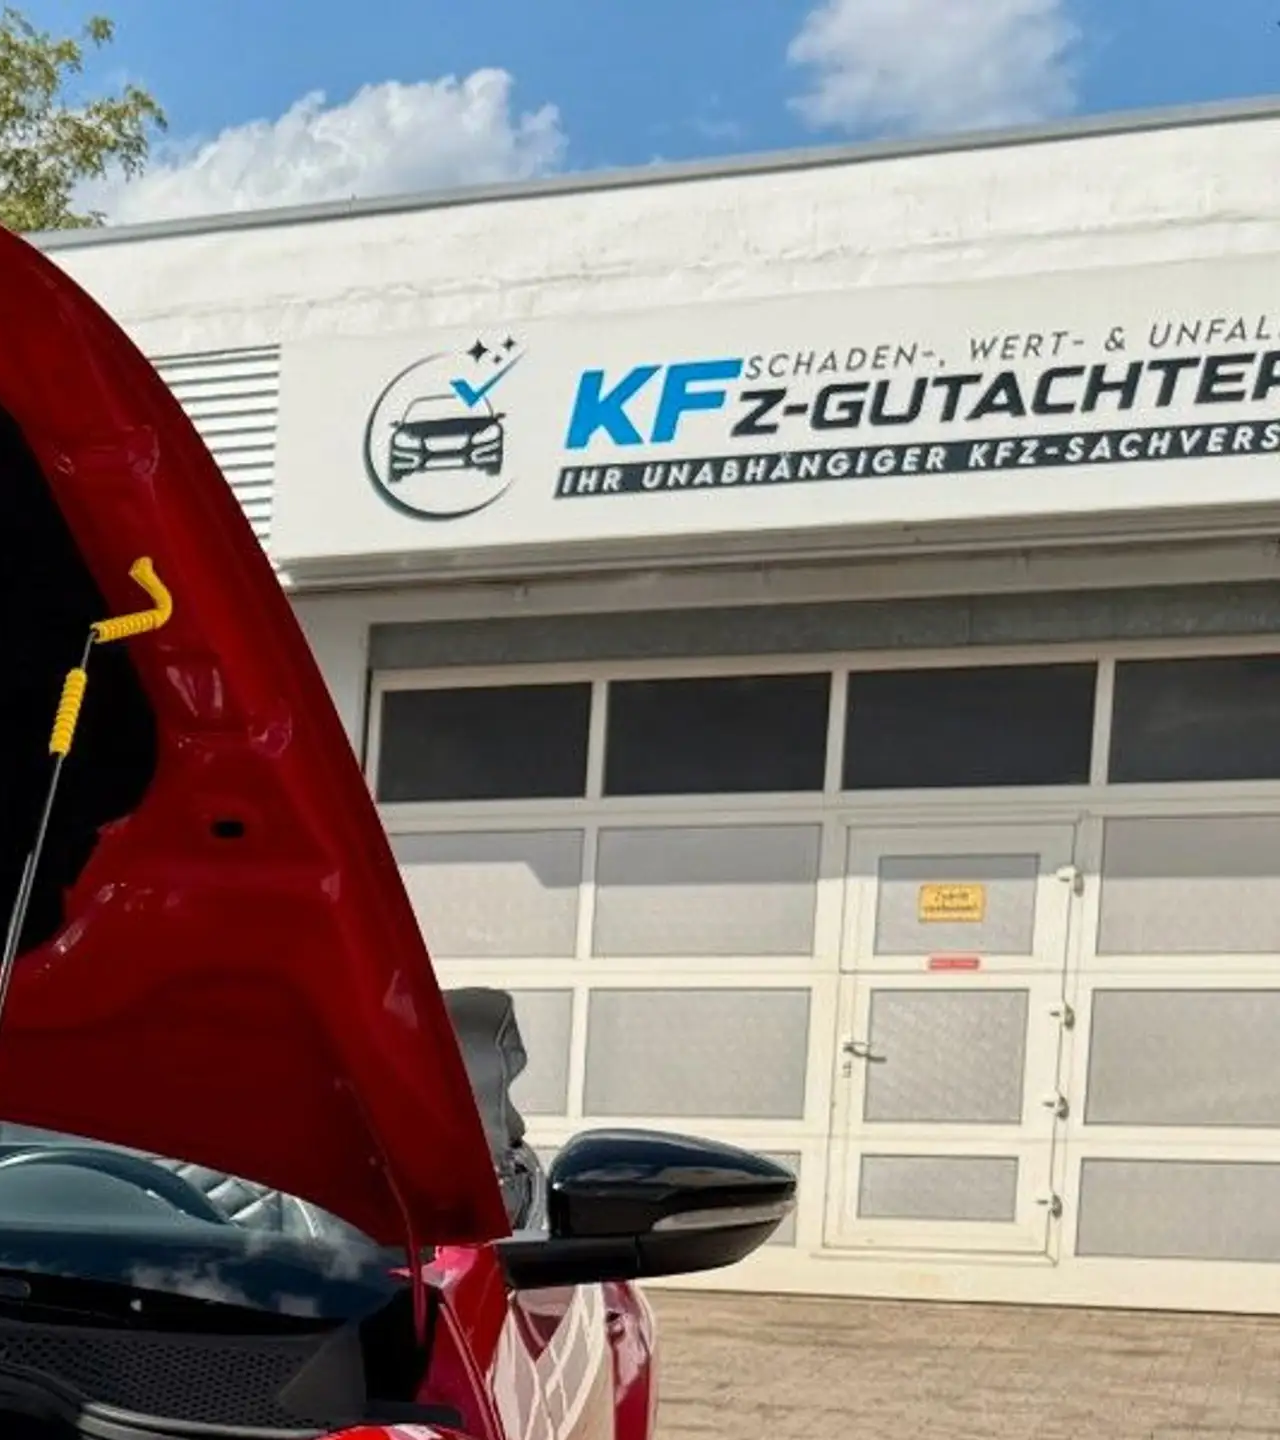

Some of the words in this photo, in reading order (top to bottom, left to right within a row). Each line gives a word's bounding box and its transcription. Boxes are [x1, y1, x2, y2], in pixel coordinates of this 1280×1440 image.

[969, 330, 1085, 362] WERT-
[1104, 325, 1126, 351] &
[559, 467, 624, 494] IHR
[641, 446, 945, 490] UNABHÄNGIGER
